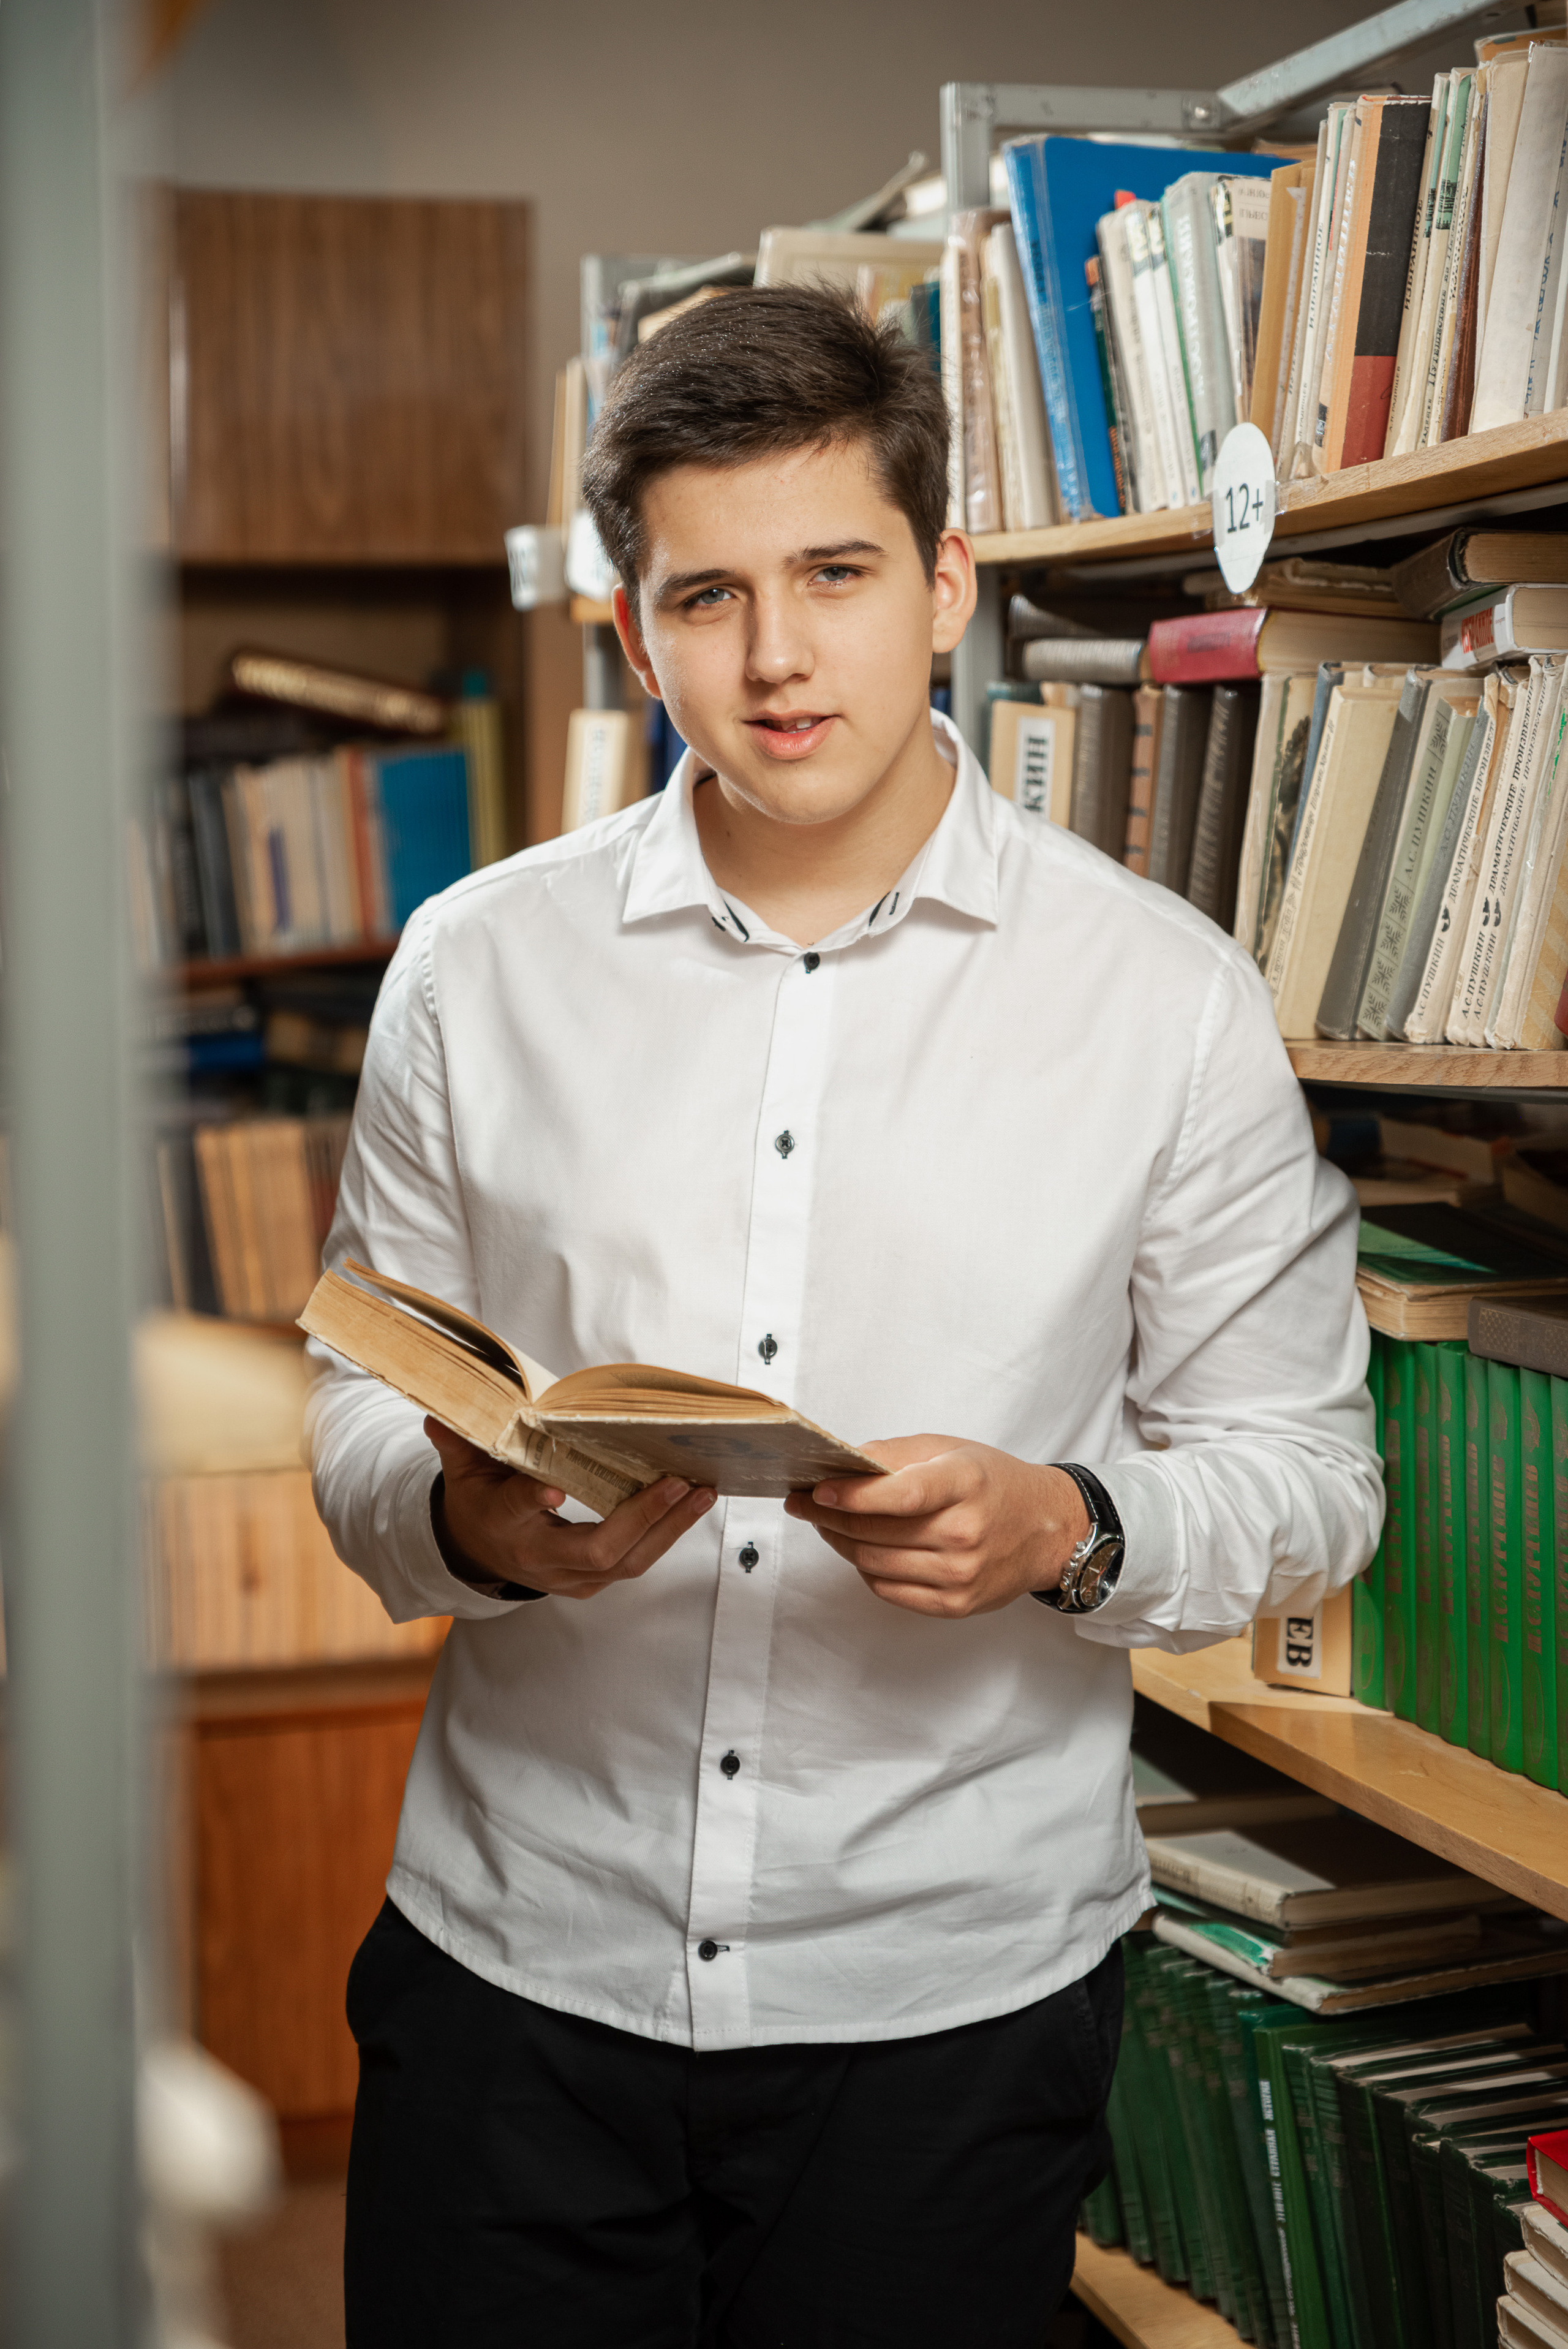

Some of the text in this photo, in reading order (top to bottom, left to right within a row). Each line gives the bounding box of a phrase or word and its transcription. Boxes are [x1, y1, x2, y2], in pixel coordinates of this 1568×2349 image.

[1308, 222, 1324, 329] ИЗБРАННОЕ
[1404, 199, 1423, 311] ИЗБРАННОЕ
[1226, 483, 1264, 534] 12+
[1449, 795, 1480, 904] ДРАМАТИЧЕСКИЕ
[1489, 784, 1517, 896] ДРАМАТИЧЕСКИЕ
[1500, 784, 1527, 896] ДРАМАТИЧЕСКИЕ
[1287, 1617, 1314, 1668] ЕВ
